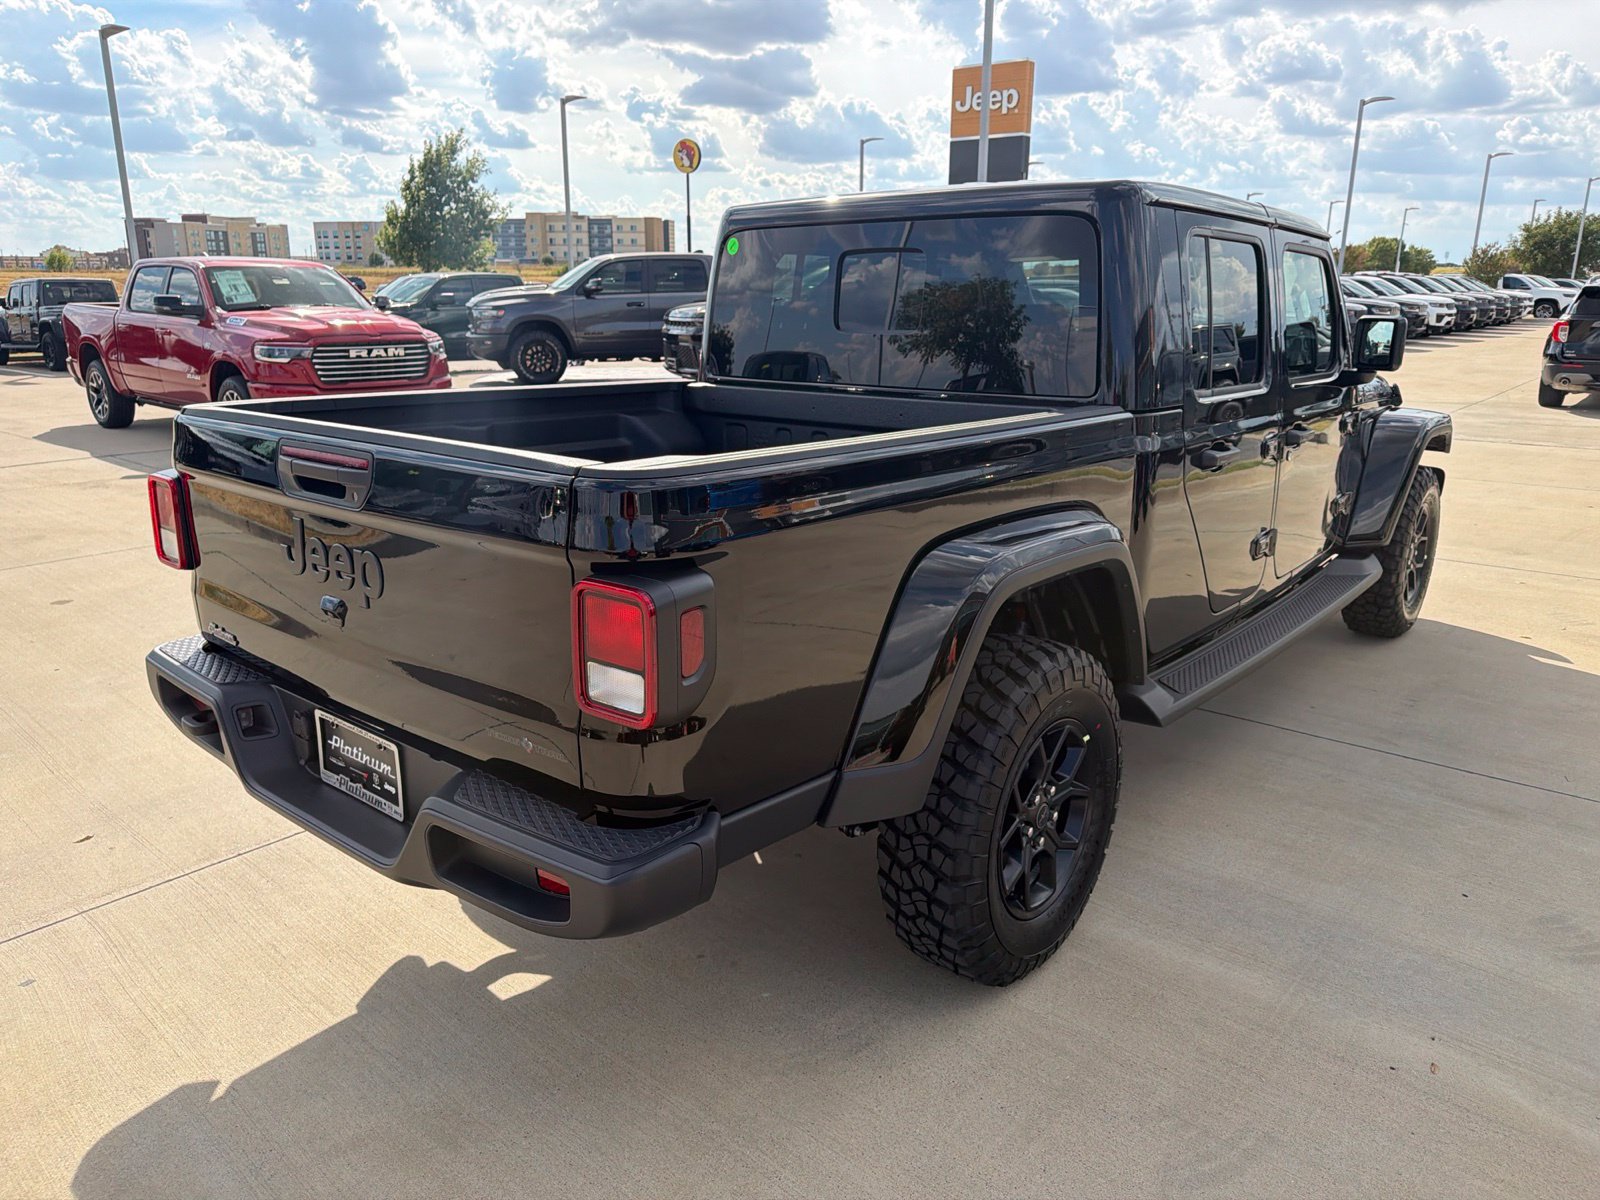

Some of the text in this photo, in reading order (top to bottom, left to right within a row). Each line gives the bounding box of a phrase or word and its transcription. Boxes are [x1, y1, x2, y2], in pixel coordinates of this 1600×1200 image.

[955, 86, 1019, 115] Jeep
[349, 347, 405, 358] RAM
[280, 516, 384, 609] Jeep
[327, 735, 396, 779] Platinum
